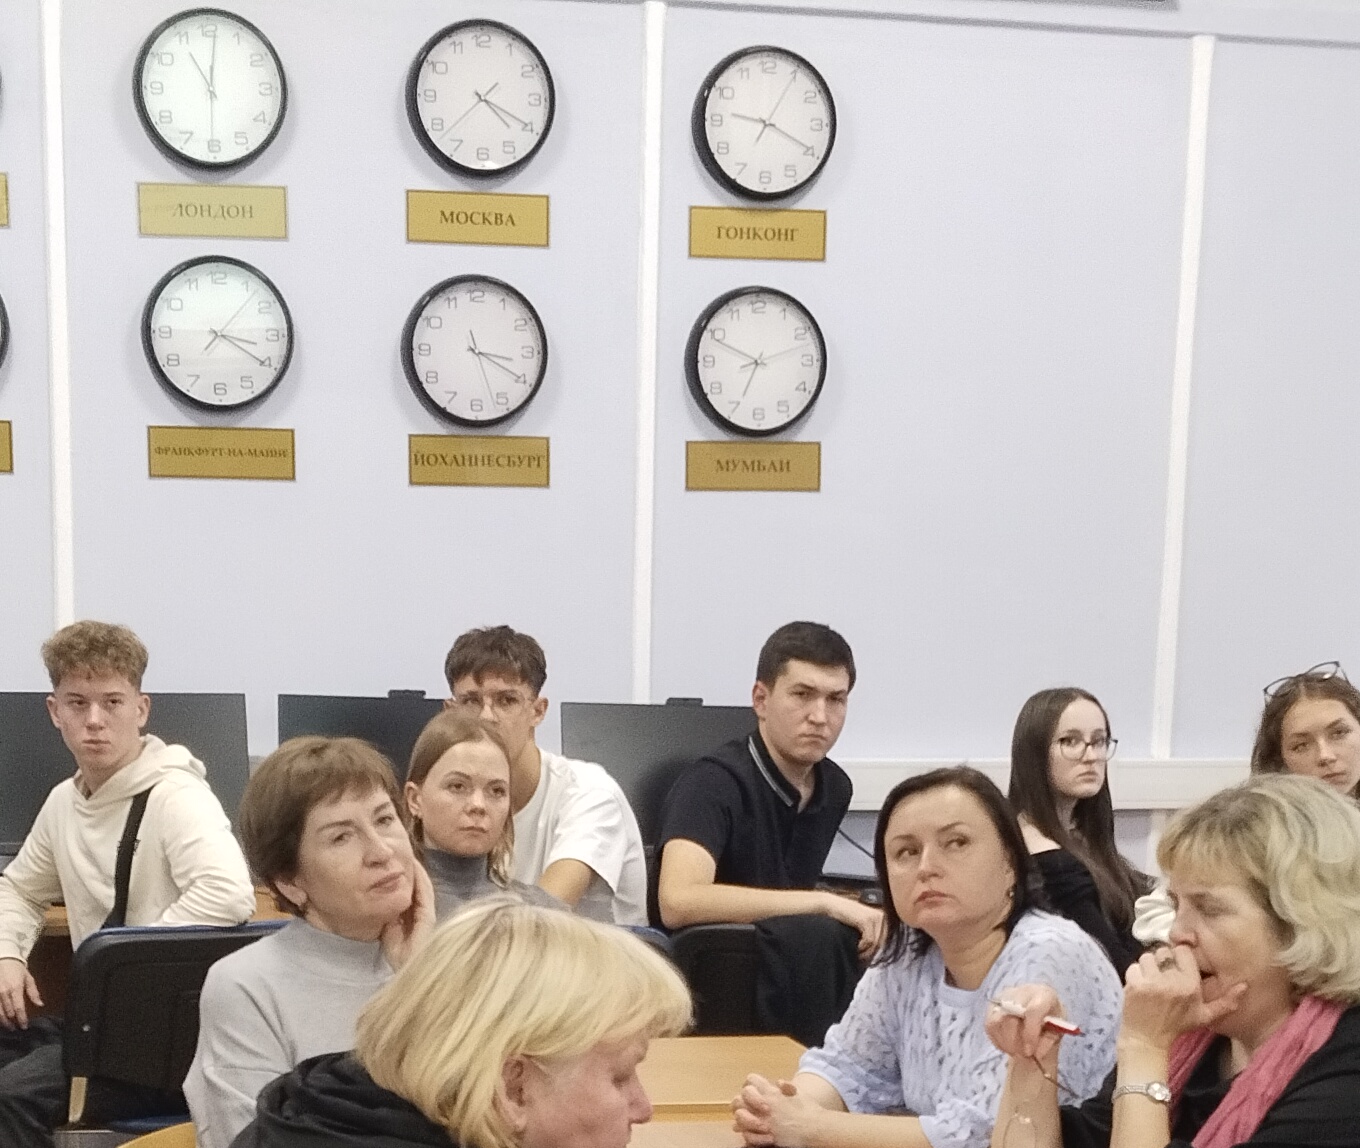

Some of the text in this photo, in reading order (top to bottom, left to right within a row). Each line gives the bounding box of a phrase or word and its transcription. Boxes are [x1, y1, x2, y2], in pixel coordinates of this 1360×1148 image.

[197, 24, 217, 38] 12
[175, 31, 189, 45] 11
[233, 32, 240, 45] 1
[472, 34, 491, 48] 12
[450, 41, 463, 54] 11
[505, 43, 512, 56] 1
[153, 52, 174, 66] 10
[250, 53, 264, 67] 2
[428, 61, 448, 75] 10
[521, 65, 534, 78] 2
[738, 67, 750, 80] 11
[759, 61, 777, 74] 12
[790, 69, 797, 82] 1
[150, 81, 163, 95] 9
[259, 82, 272, 96] 3
[715, 86, 735, 100] 10
[424, 89, 437, 103] 9
[528, 93, 541, 106] 3
[803, 91, 817, 104] 2
[159, 110, 173, 124] 8
[252, 111, 265, 124] 4
[711, 113, 723, 127] 9
[432, 118, 444, 131] 8
[521, 121, 534, 133] 4
[810, 118, 823, 132] 3
[179, 131, 194, 144] 7
[234, 131, 248, 145] 5
[208, 139, 221, 152] 6
[450, 139, 463, 151] 7
[503, 141, 515, 154] 5
[717, 141, 729, 154] 8
[802, 145, 815, 157] 4
[477, 147, 489, 160] 6
[735, 162, 748, 174] 7
[784, 164, 797, 177] 5
[759, 170, 772, 183] 6
[172, 203, 253, 220] ЛОНДОН
[439, 210, 516, 226] МОСКВА
[717, 226, 799, 242] ГОНКОНГ
[185, 278, 198, 291] 11
[206, 271, 227, 285] 12
[241, 280, 248, 293] 1
[444, 296, 457, 309] 11
[466, 289, 485, 303] 12
[163, 297, 183, 311] 10
[258, 300, 271, 314] 2
[499, 298, 506, 310] 1
[748, 300, 766, 314] 12
[727, 307, 740, 321] 11
[780, 308, 786, 321] 1
[422, 316, 443, 329] 10
[514, 318, 527, 331] 2
[159, 325, 172, 339] 9
[266, 328, 279, 342] 3
[710, 328, 726, 341] 10
[794, 327, 807, 340] 2
[418, 343, 431, 356] 9
[521, 346, 534, 359] 3
[167, 353, 180, 367] 8
[259, 356, 272, 368] 4
[703, 355, 715, 368] 9
[801, 354, 813, 367] 3
[187, 374, 200, 387] 7
[240, 375, 253, 389] 5
[425, 371, 438, 383] 8
[514, 373, 526, 384] 4
[214, 382, 227, 395] 6
[710, 381, 722, 394] 8
[795, 381, 807, 393] 4
[444, 390, 457, 403] 7
[496, 391, 509, 405] 5
[470, 398, 483, 411] 6
[728, 400, 740, 412] 7
[777, 400, 790, 413] 5
[752, 407, 765, 420] 6
[413, 450, 545, 468] ЙОХАННЕСБУРГ
